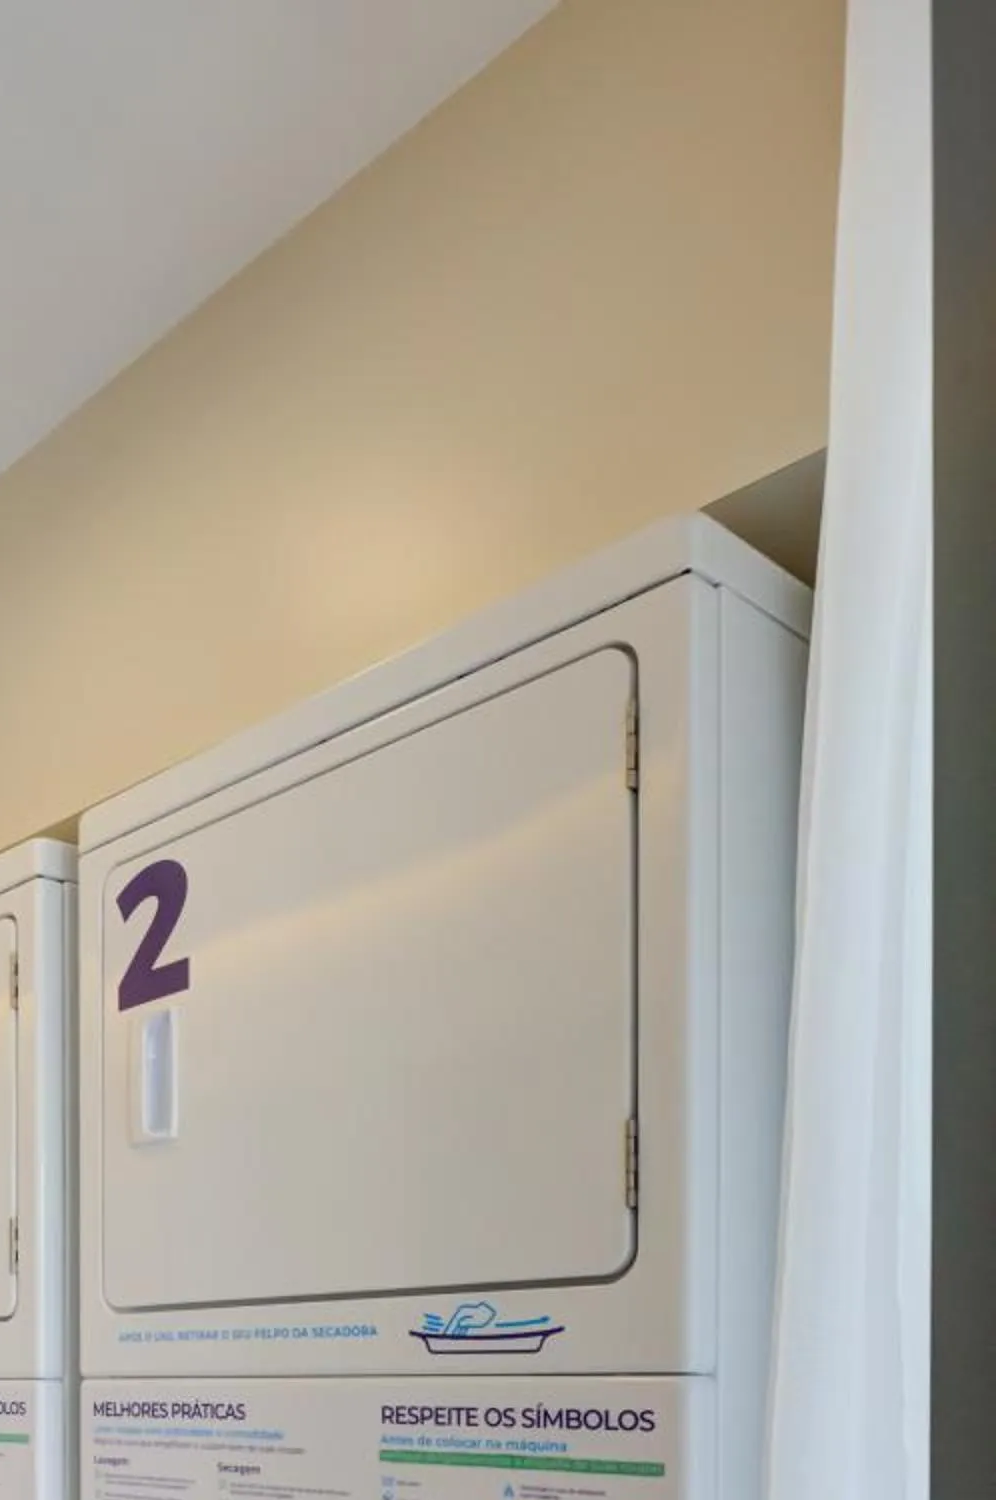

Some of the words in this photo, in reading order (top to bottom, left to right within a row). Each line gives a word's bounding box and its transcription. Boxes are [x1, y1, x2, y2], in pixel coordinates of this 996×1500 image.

[115, 859, 190, 1012] 2
[292, 1326, 308, 1338] DA
[312, 1324, 377, 1337] SECADORA
[93, 1401, 168, 1419] MELHORES
[171, 1398, 246, 1421] PRÁTICAS
[381, 1404, 479, 1427] RESPEITE
[484, 1406, 516, 1428] OS
[521, 1402, 656, 1433] SÍMBOLOS
[417, 1435, 433, 1446] de
[436, 1436, 481, 1449] colocar
[485, 1439, 502, 1450] na
[506, 1438, 568, 1453] máquina
